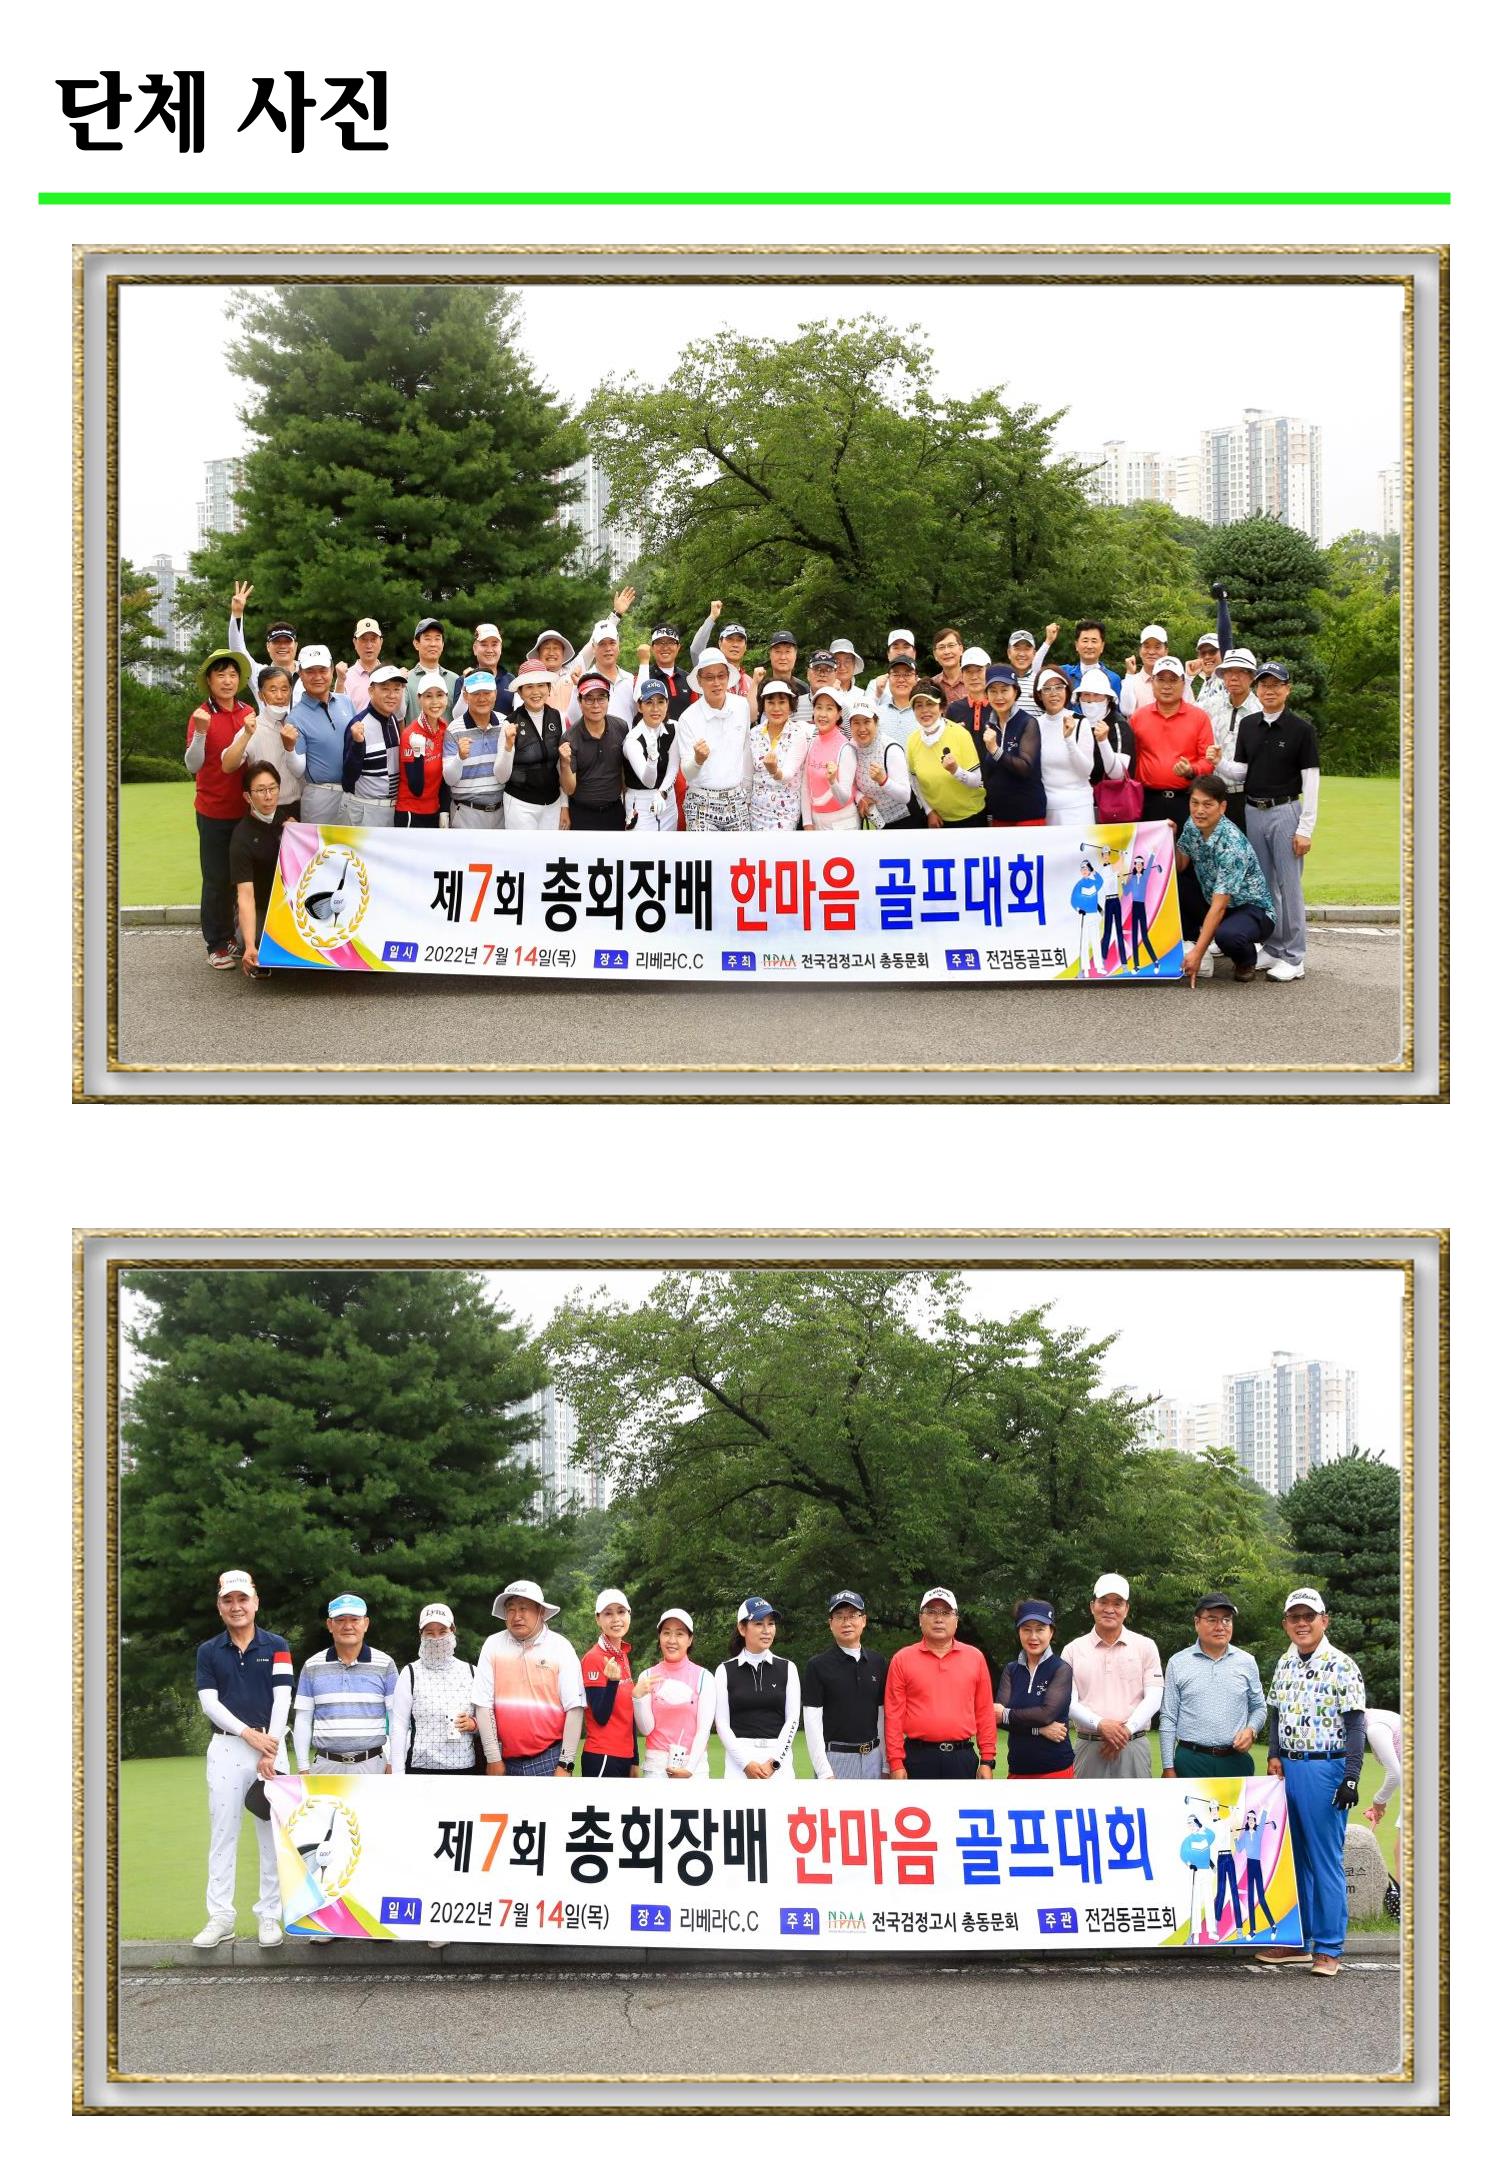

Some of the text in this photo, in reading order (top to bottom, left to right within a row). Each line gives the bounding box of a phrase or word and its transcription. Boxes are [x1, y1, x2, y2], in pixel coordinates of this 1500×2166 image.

[430, 854, 1046, 932] 제7회 총회장배 한마음 골프대회
[424, 945, 576, 968] 2022년 7월 14일(목)
[635, 951, 704, 970] 리베라C.C
[801, 953, 875, 970] 전국검정고시
[879, 951, 929, 969] 총동문회
[985, 949, 1068, 970] 전검동골프회
[433, 1805, 1154, 1885] 제7회 총회장배 한마음 골프대회
[430, 1900, 609, 1930] 2022년 7월 14일(목)
[680, 1909, 759, 1933] 리베라C.C
[872, 1912, 957, 1933] 전국검정고시
[961, 1911, 1019, 1932] 총동문회
[1085, 1907, 1177, 1933] 전검동골프회
